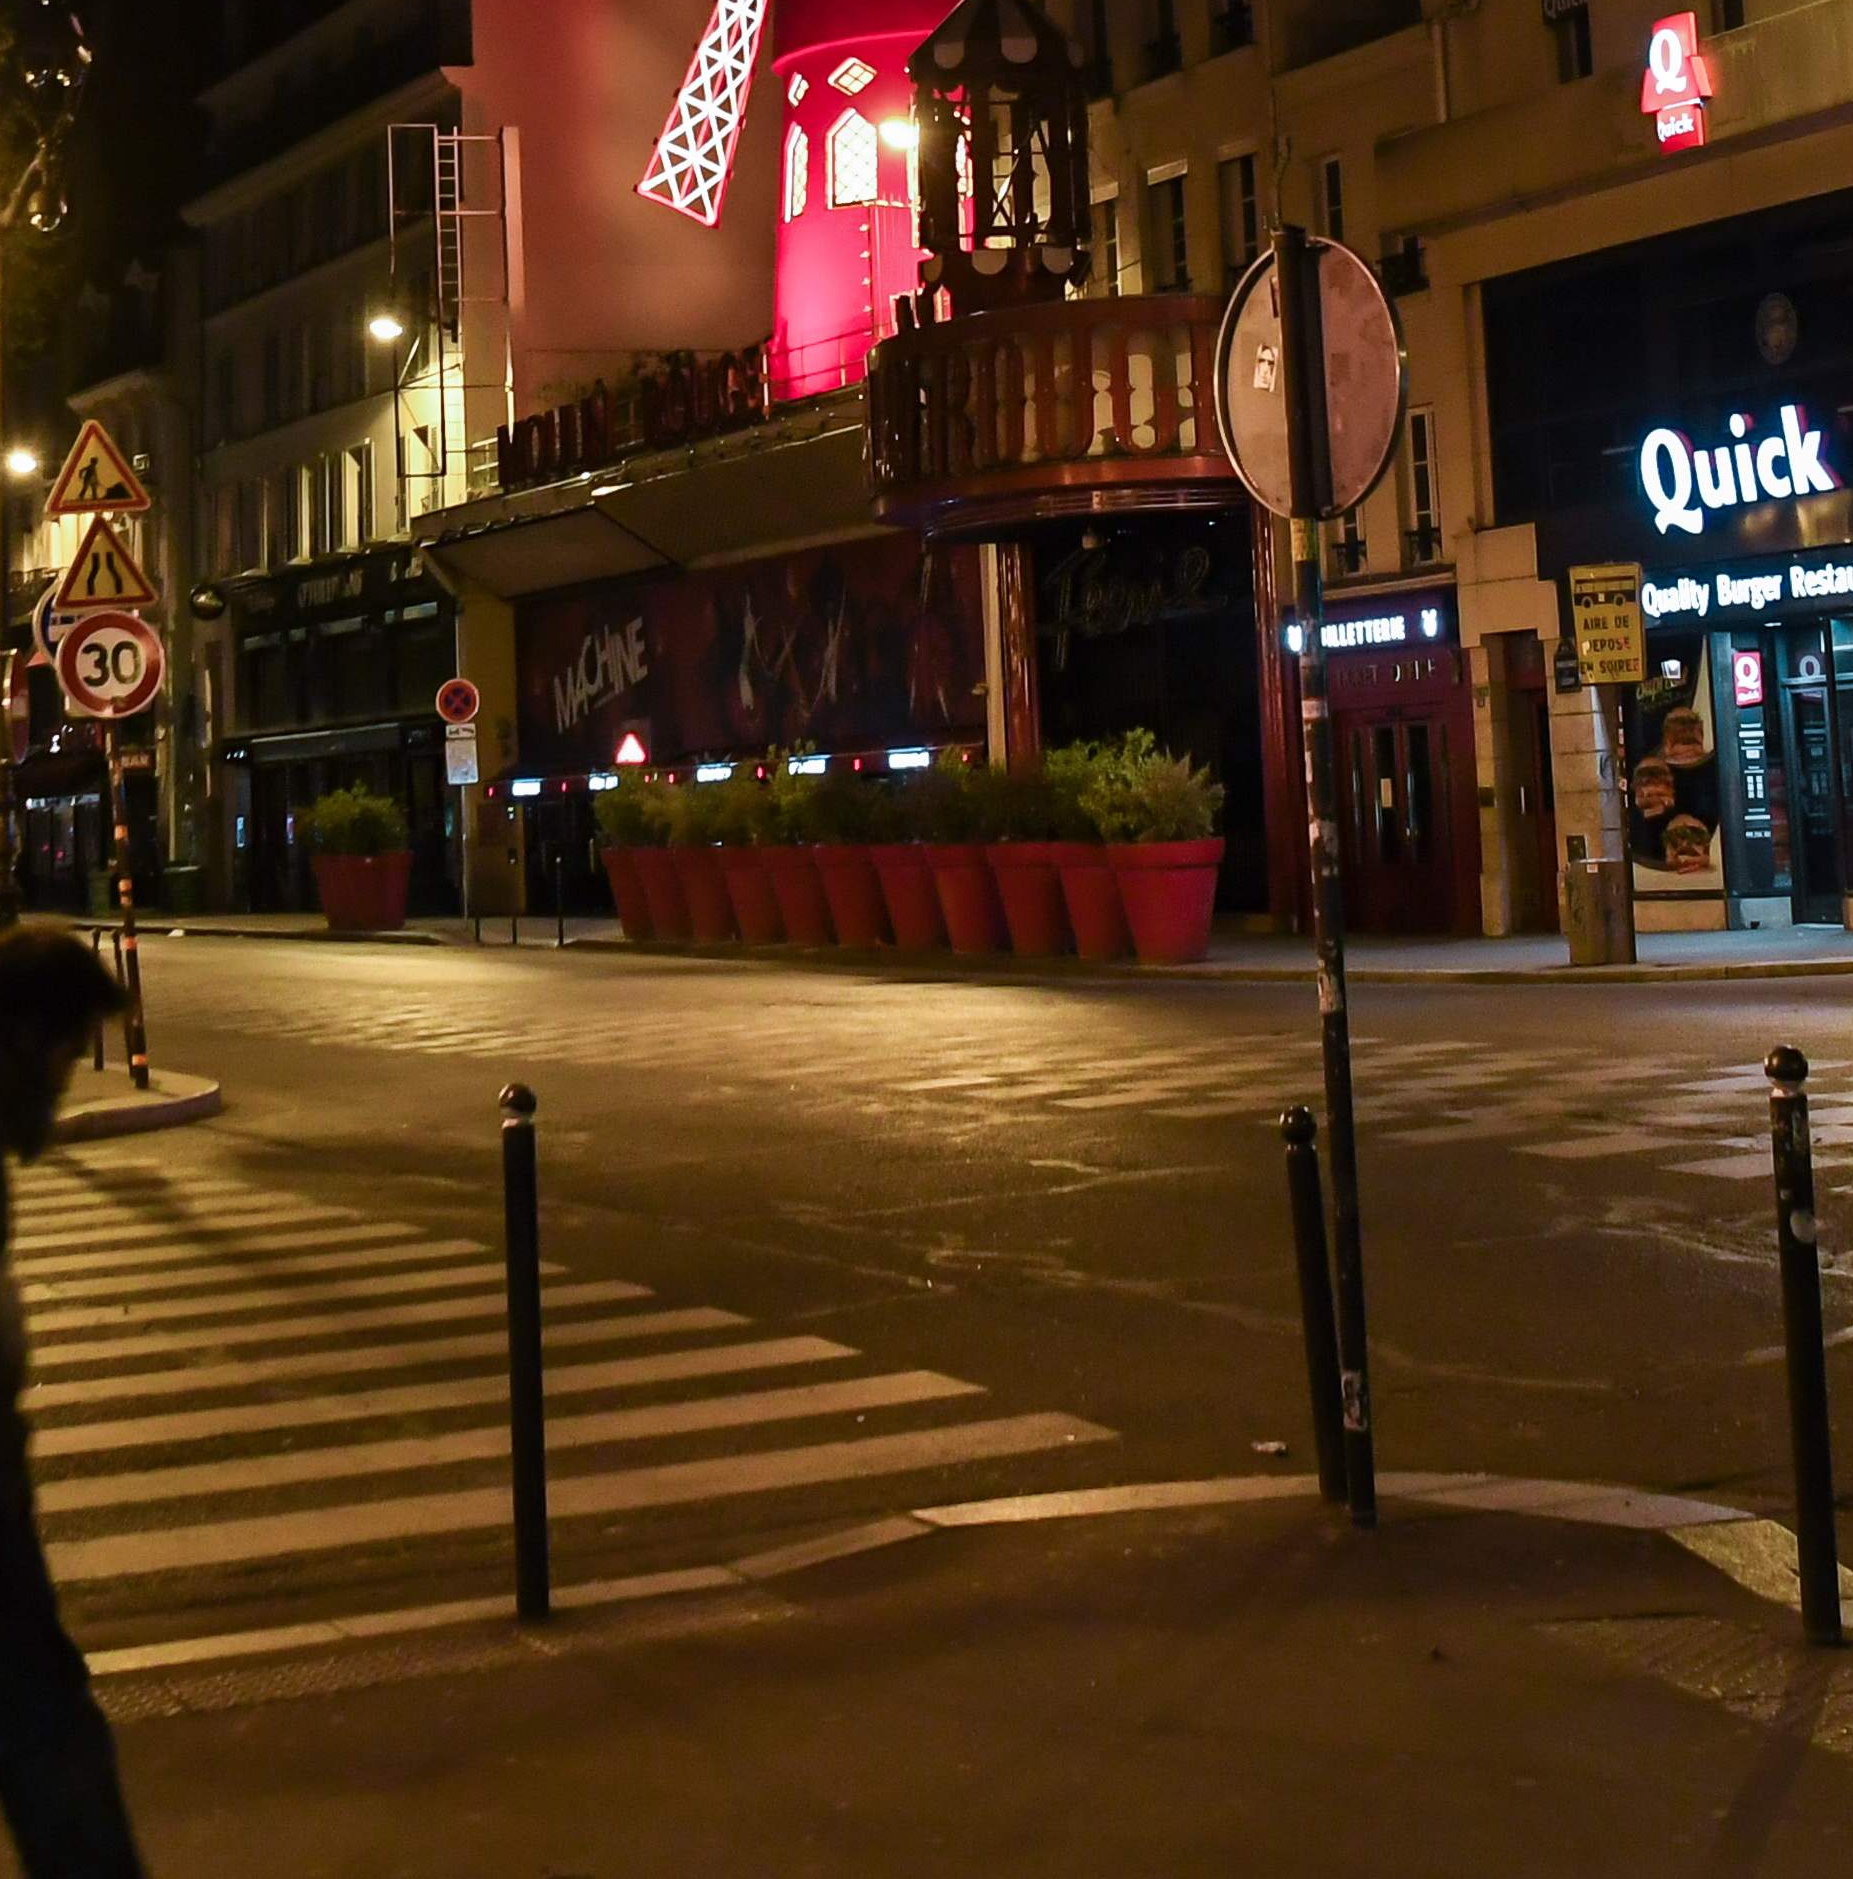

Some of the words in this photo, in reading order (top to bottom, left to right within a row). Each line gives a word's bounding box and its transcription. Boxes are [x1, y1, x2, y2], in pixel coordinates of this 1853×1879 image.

[1649, 28, 1687, 95] Q
[1657, 113, 1694, 142] Quick
[1640, 404, 1837, 535] Quick
[1641, 578, 1709, 618] Quality
[1716, 574, 1782, 609] Burger
[1583, 615, 1608, 631] AIRE
[1614, 615, 1629, 628] DE
[80, 640, 140, 687] 30
[553, 616, 648, 734] MACHINE
